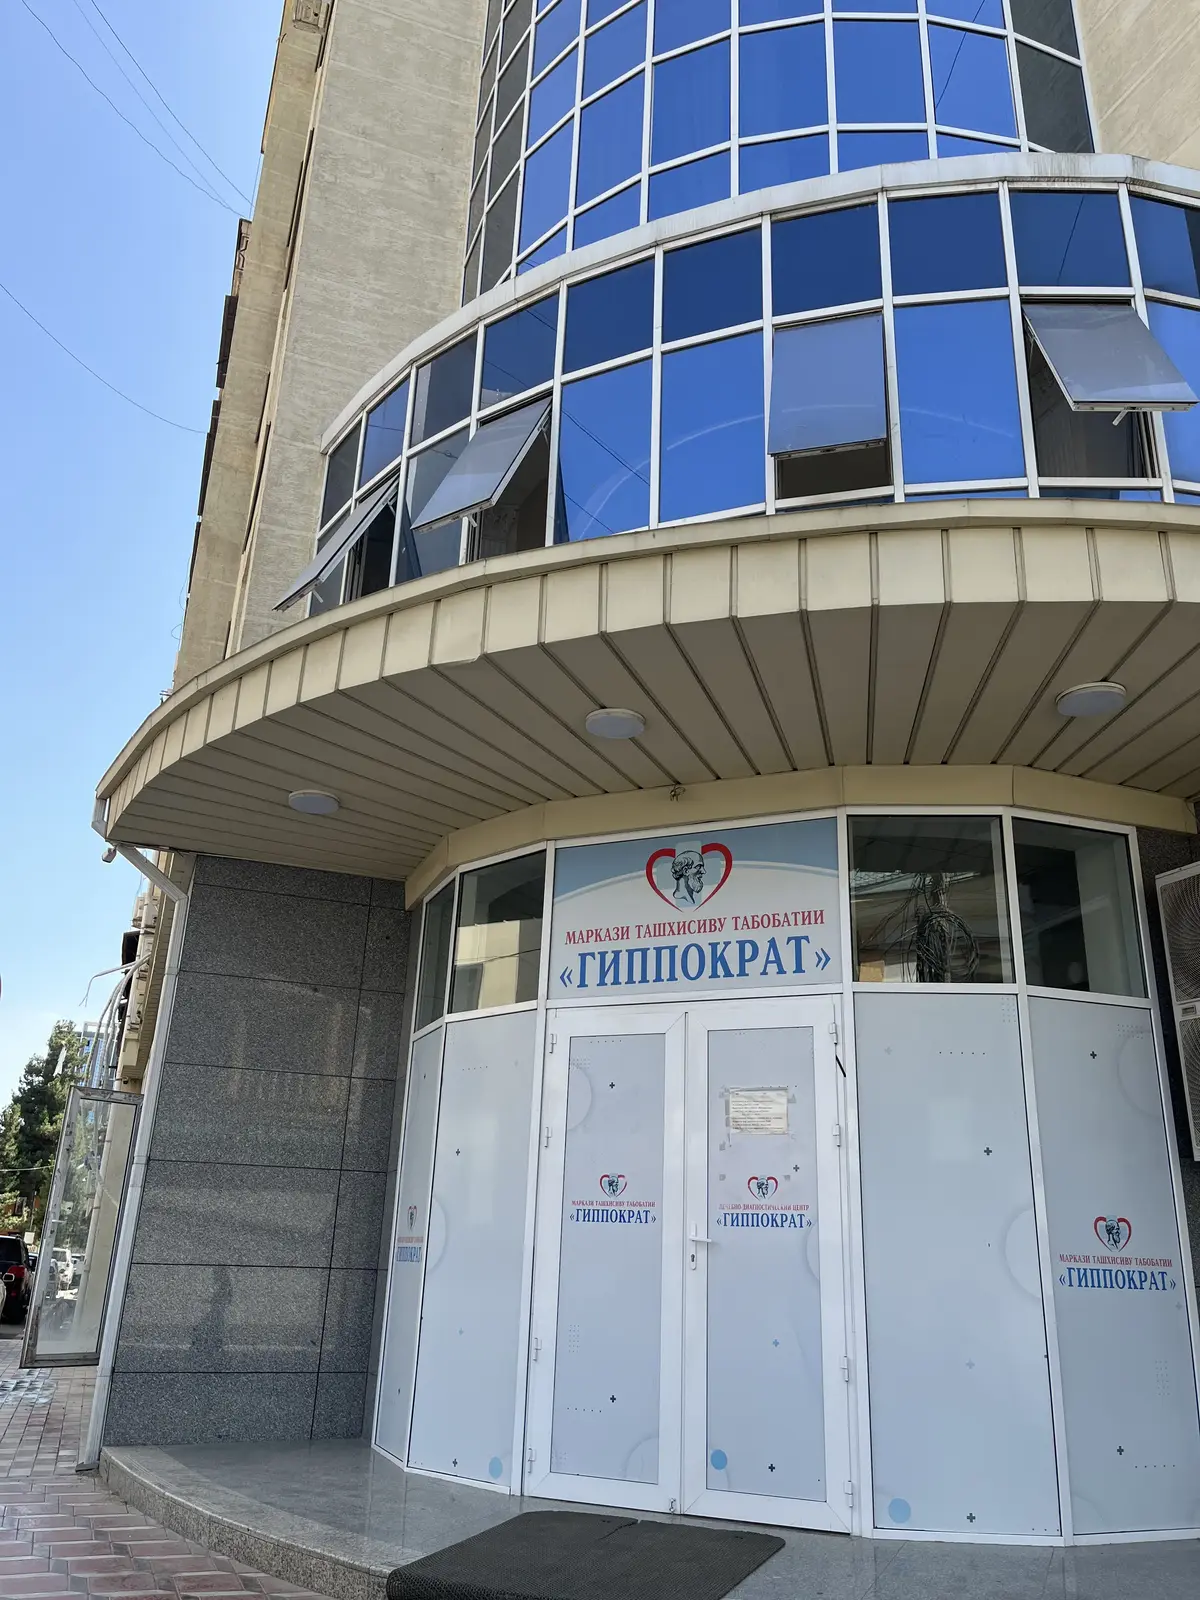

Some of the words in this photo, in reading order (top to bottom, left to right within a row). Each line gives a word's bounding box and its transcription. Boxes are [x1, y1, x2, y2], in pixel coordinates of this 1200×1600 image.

[565, 926, 630, 945] МАРКАЗИ
[635, 916, 727, 939] ТАШХИСИВУ
[732, 909, 825, 931] ТАБОБАТИИ
[559, 935, 831, 988] «ГИППОКРАТ»
[569, 1208, 657, 1224] «ГИППОКРАТ»
[716, 1212, 812, 1228] «ГИППОКРАТ»
[1059, 1253, 1091, 1264] МАРКАЗИ
[1092, 1255, 1133, 1266] ТАШХИСИВУ
[1134, 1257, 1173, 1268] ТАБОБАТИИ
[1059, 1266, 1176, 1291] «ГИППОКРАТ»
